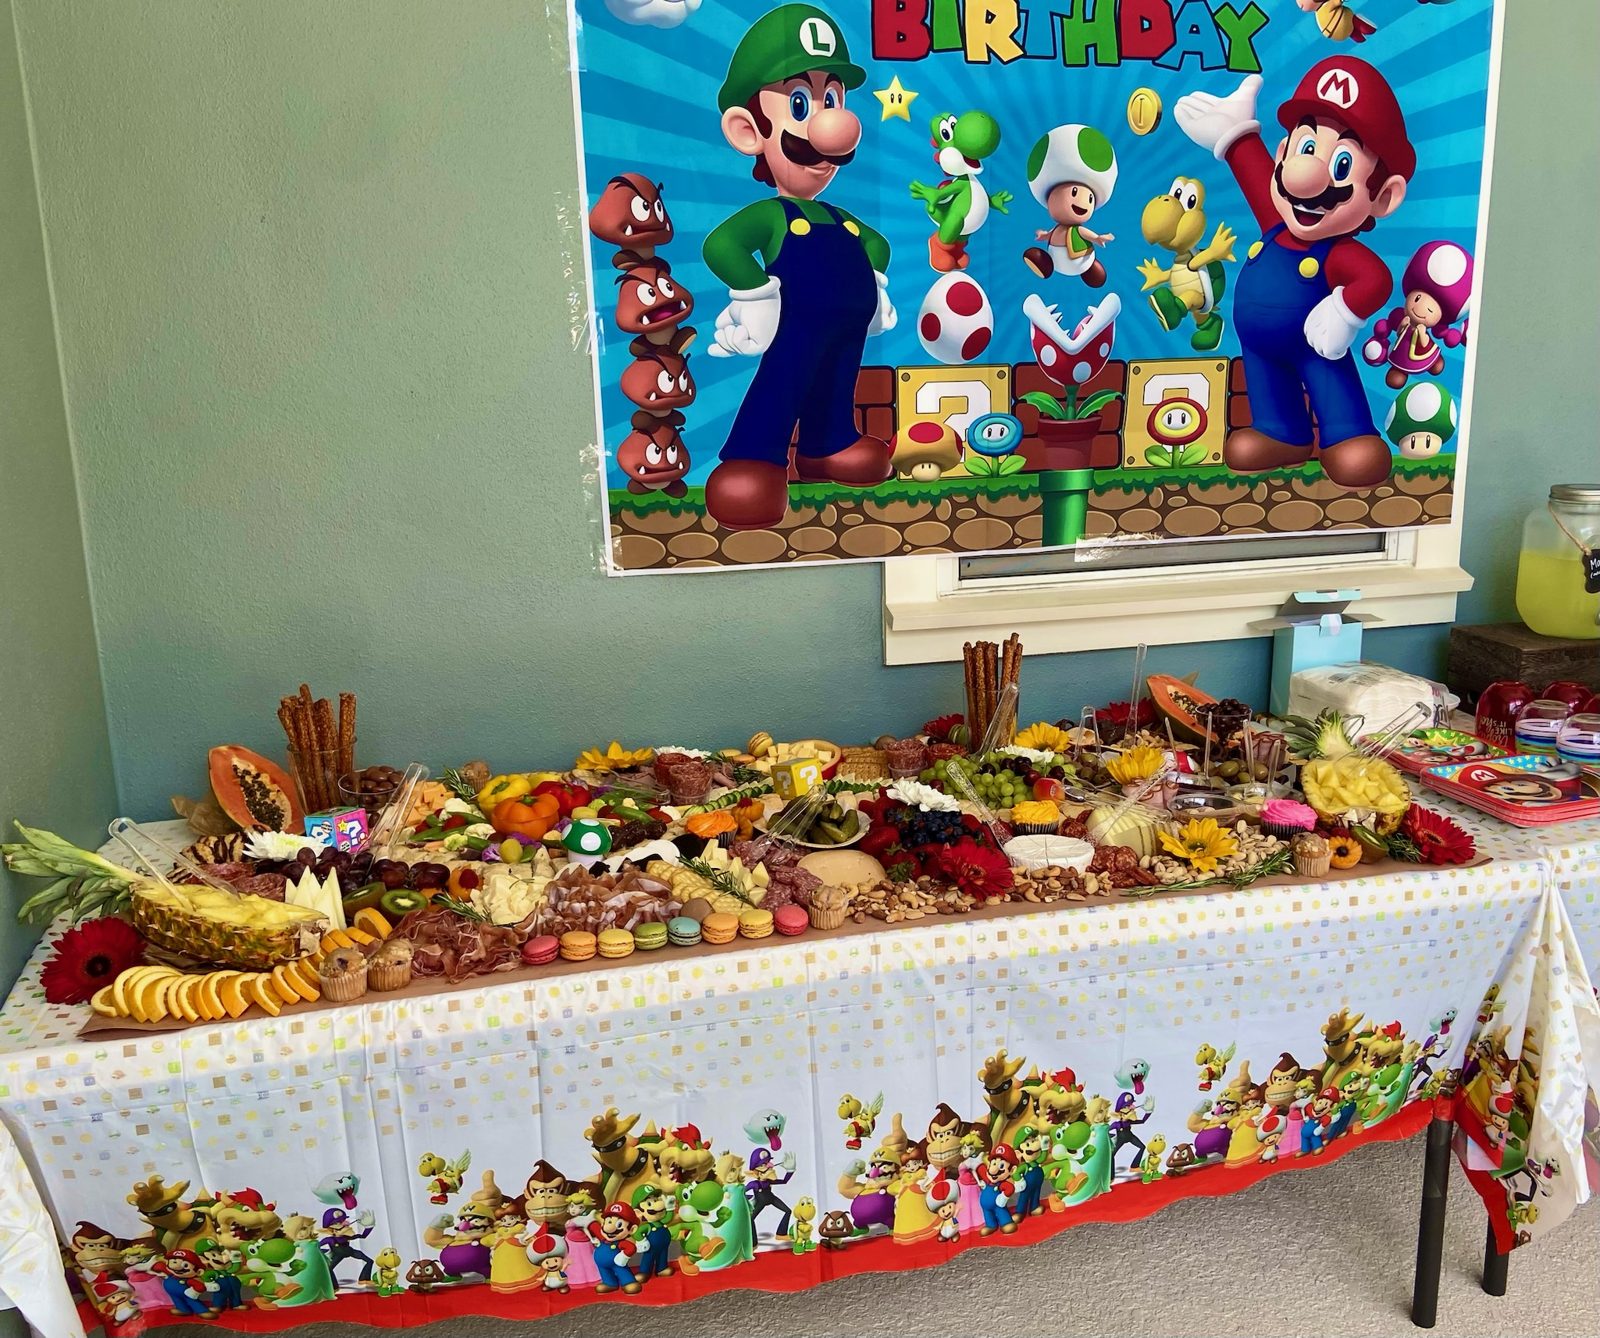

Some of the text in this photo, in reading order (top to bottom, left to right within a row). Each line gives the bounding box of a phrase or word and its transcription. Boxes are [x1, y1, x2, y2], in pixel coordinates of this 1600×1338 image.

[808, 22, 831, 53] L
[872, 0, 1270, 72] BIRTHDAY
[1320, 71, 1351, 105] M
